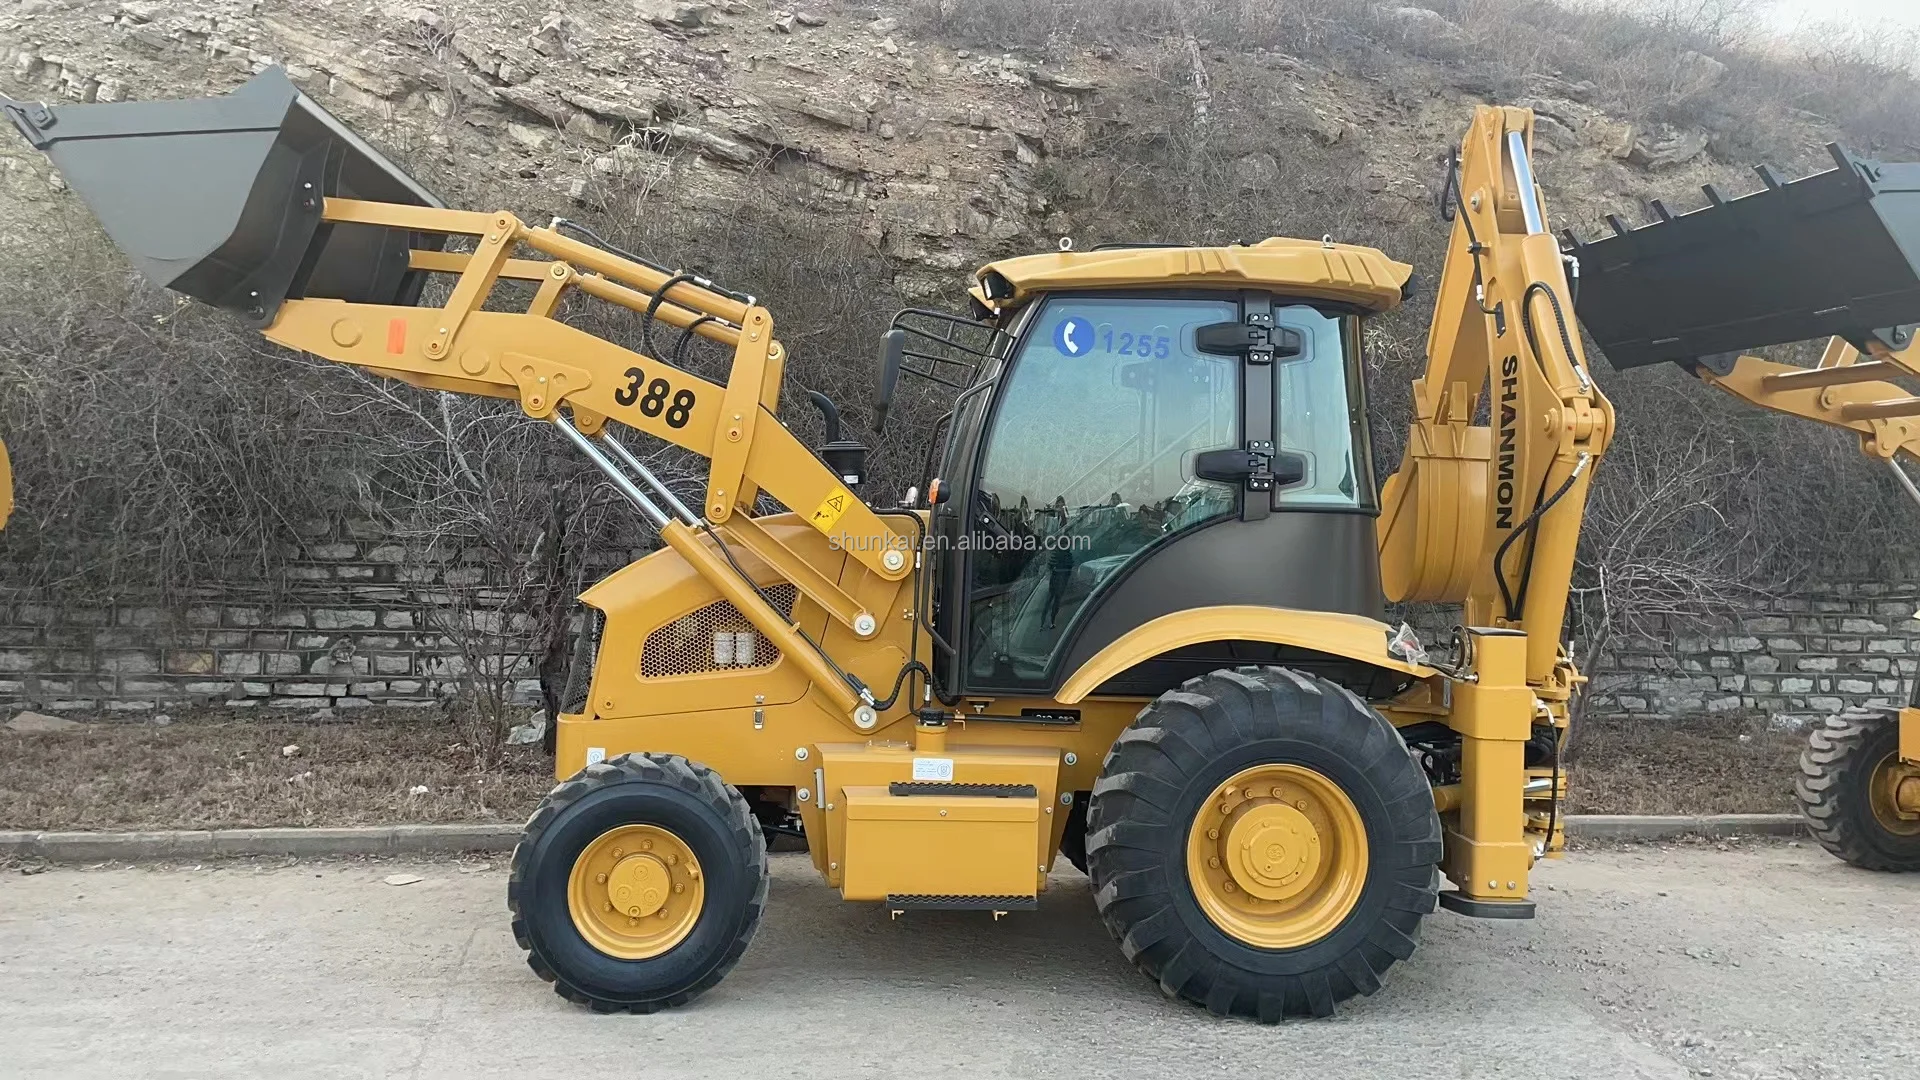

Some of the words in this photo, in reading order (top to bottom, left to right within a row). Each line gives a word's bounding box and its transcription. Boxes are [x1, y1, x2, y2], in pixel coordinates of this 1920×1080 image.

[1104, 330, 1169, 359] 1255
[615, 367, 695, 429] 388
[1496, 355, 1518, 529] SHANMON
